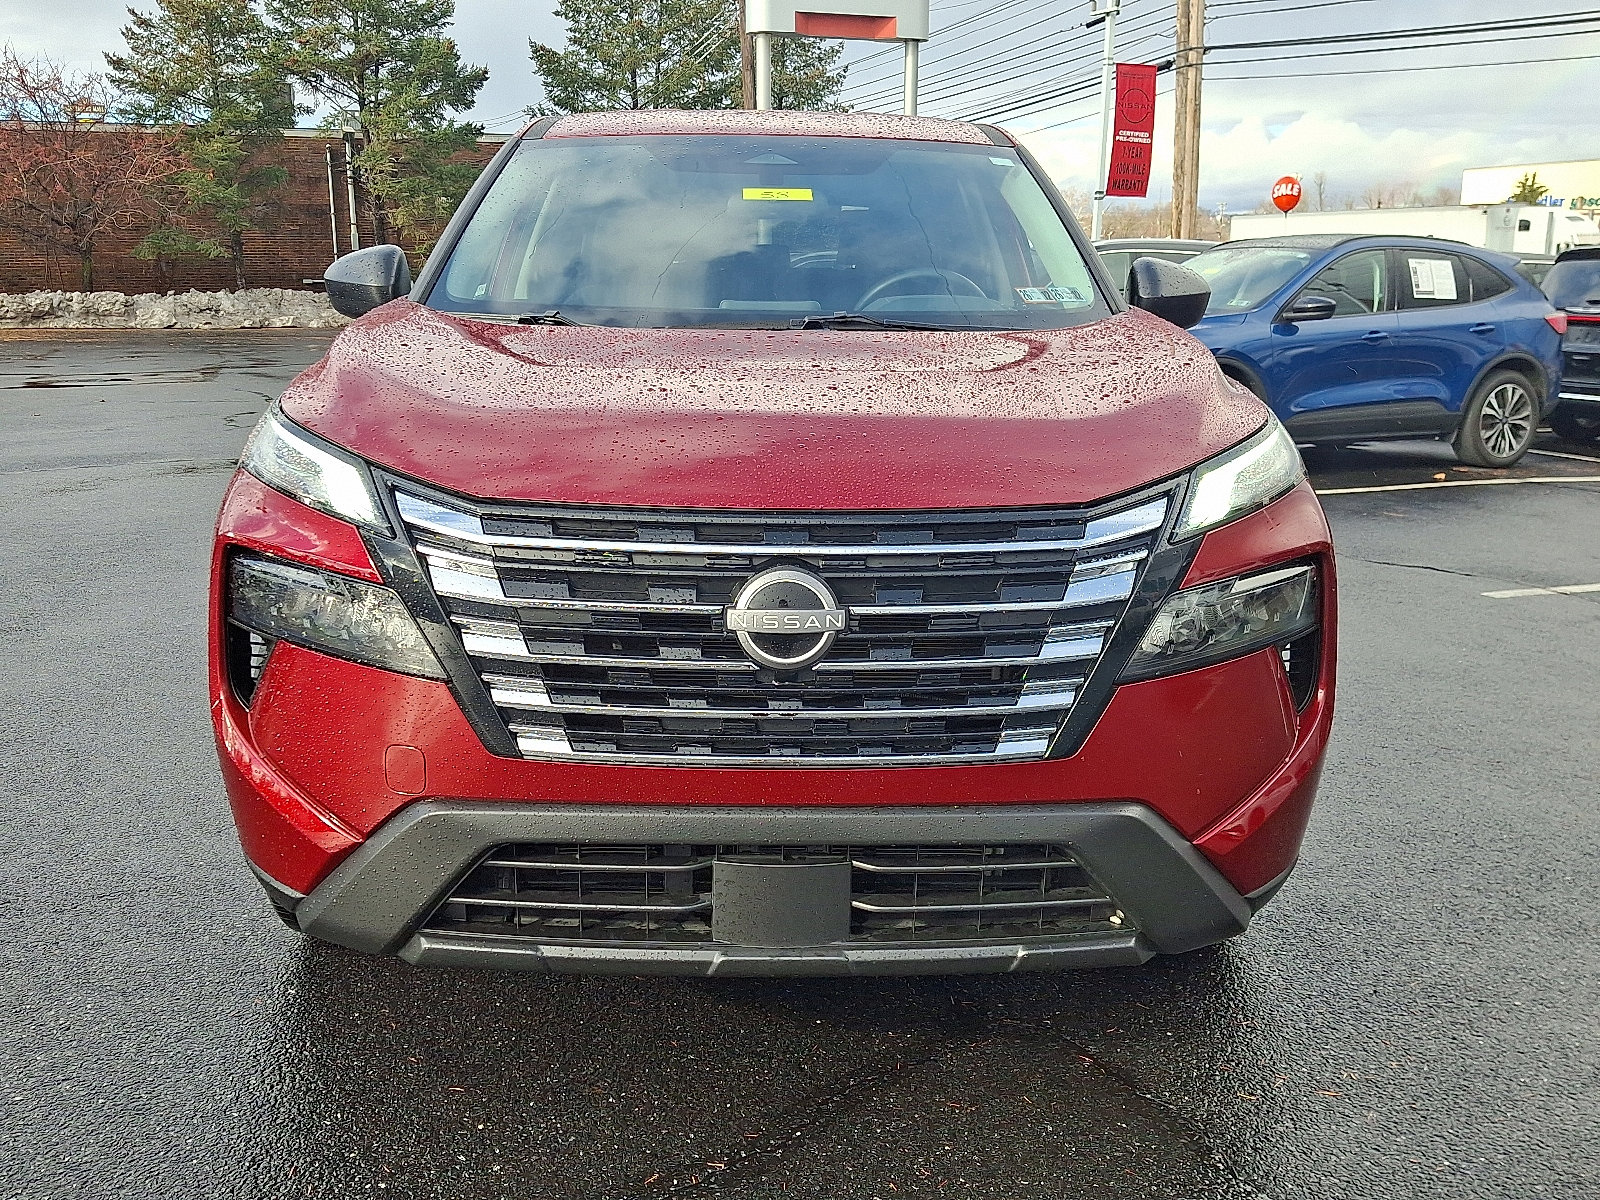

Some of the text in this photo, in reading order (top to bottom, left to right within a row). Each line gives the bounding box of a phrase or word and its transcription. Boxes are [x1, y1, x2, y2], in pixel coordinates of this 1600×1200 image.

[1118, 102, 1152, 111] NISSAN
[1119, 130, 1149, 138] CERTIFIED
[1115, 136, 1151, 144] PRE-OWNED
[1112, 178, 1145, 191] WARRANTY
[1273, 183, 1300, 199] SALE
[730, 614, 842, 629] NISSAN
